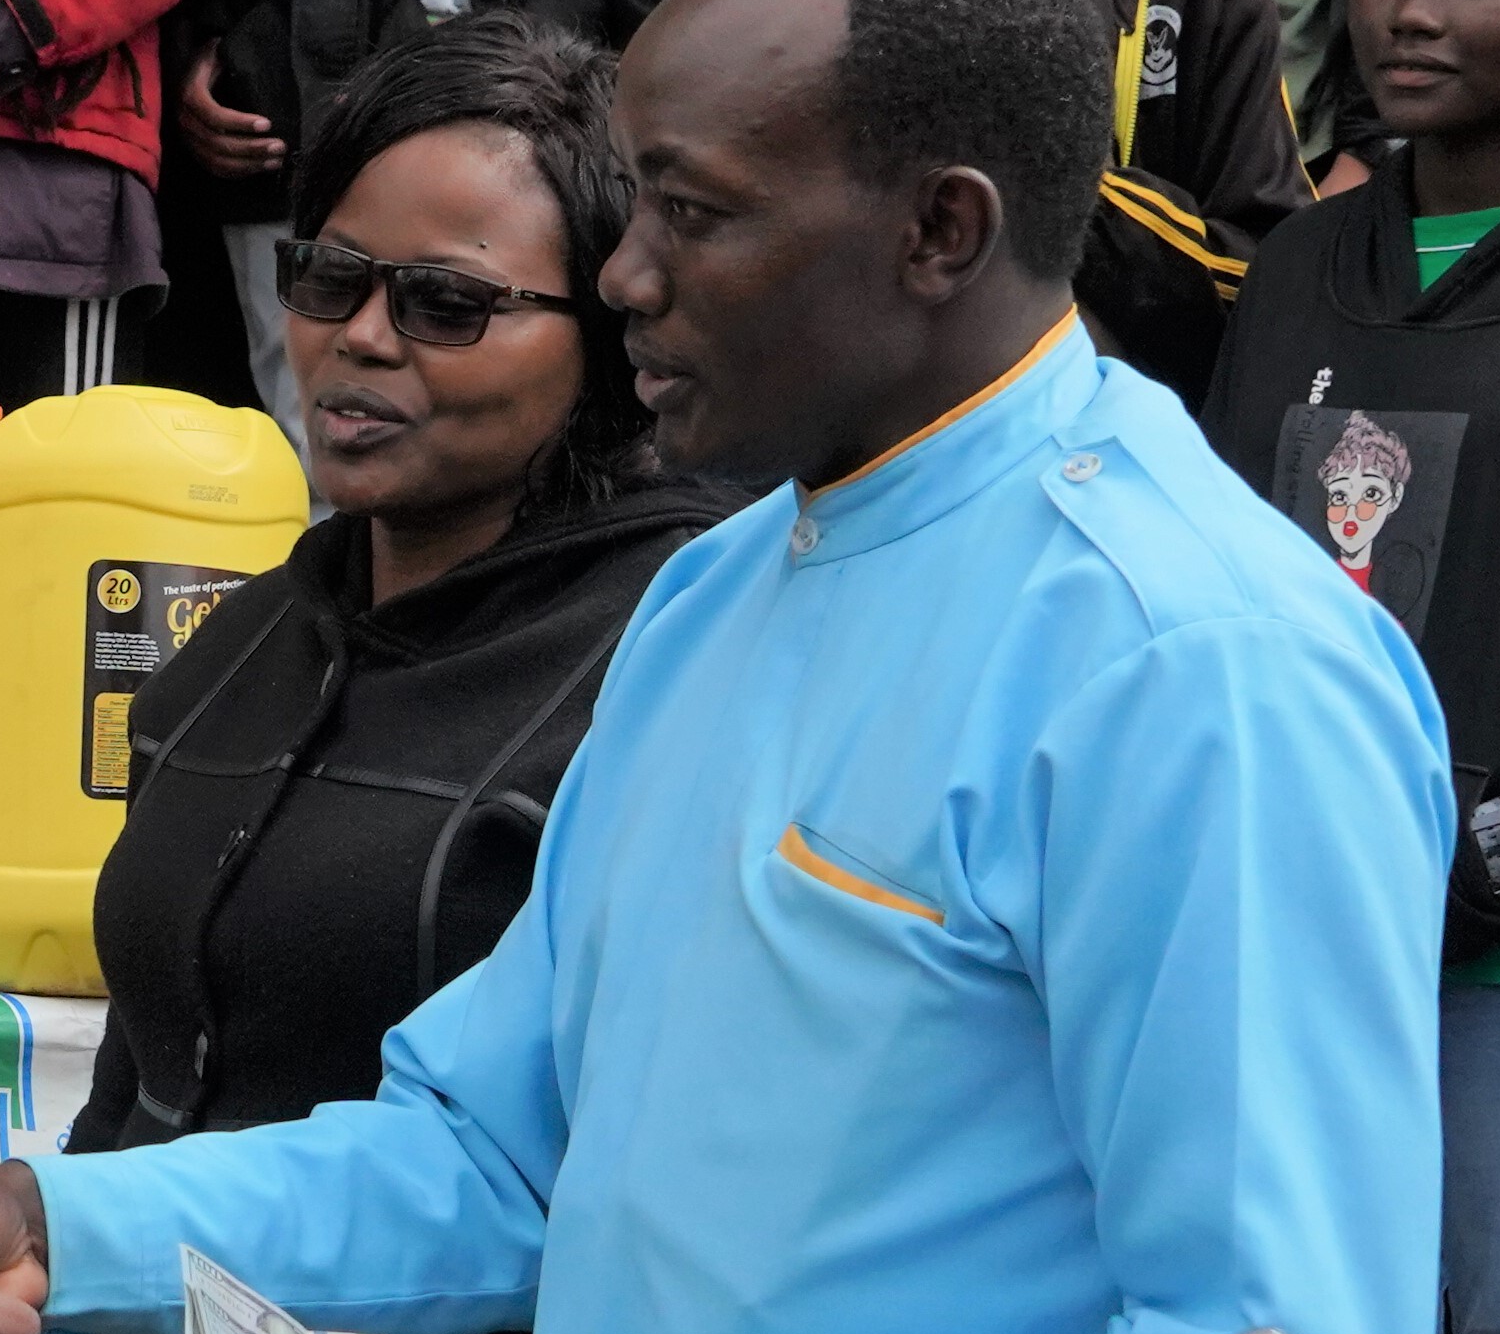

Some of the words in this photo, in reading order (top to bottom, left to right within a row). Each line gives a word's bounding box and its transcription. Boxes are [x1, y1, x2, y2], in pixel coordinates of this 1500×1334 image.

[1308, 367, 1333, 405] the
[106, 578, 132, 595] 20
[163, 586, 179, 596] The
[180, 583, 201, 594] taste
[202, 581, 212, 593] of
[108, 595, 130, 607] Ltrs
